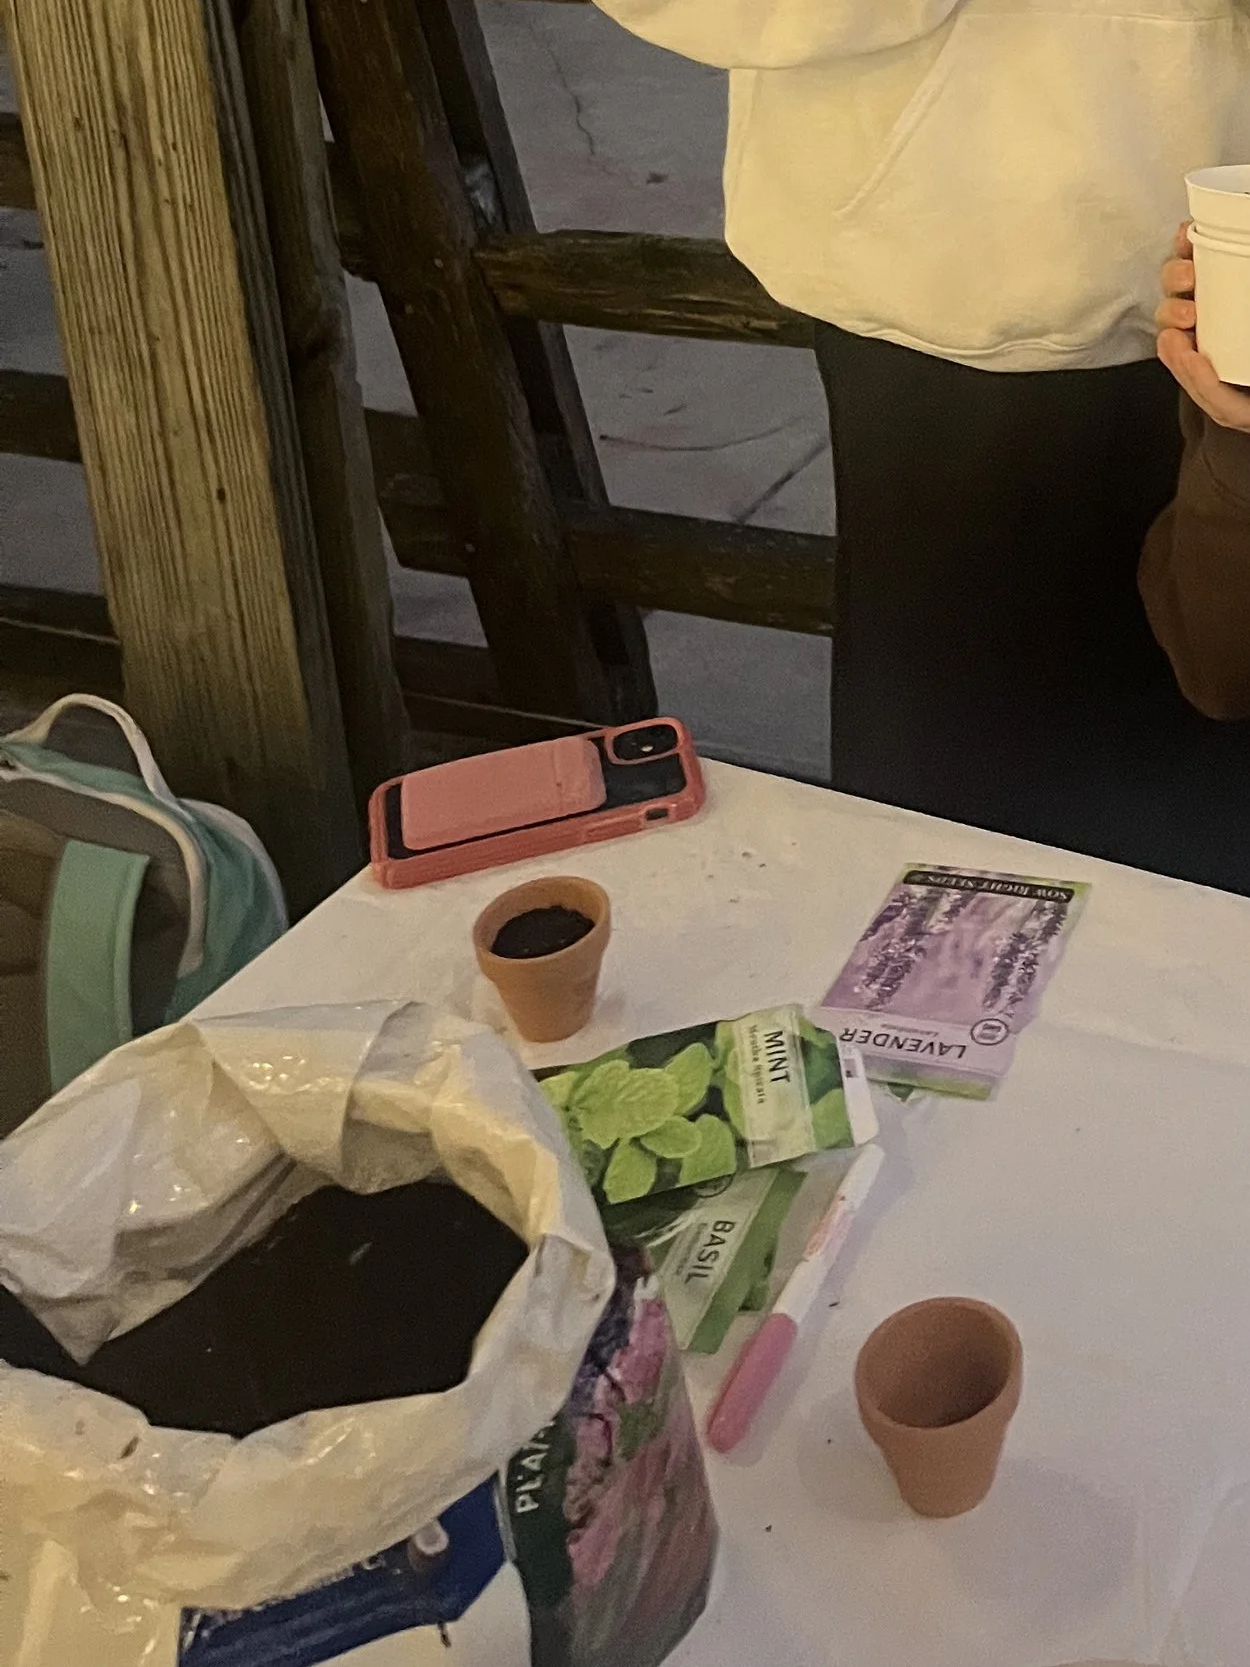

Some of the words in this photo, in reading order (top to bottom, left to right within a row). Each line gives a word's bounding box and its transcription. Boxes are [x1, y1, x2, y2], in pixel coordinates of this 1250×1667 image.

[763, 1029, 791, 1083] MINT
[839, 1027, 967, 1059] LAVENDER
[684, 1219, 738, 1284] BASIL
